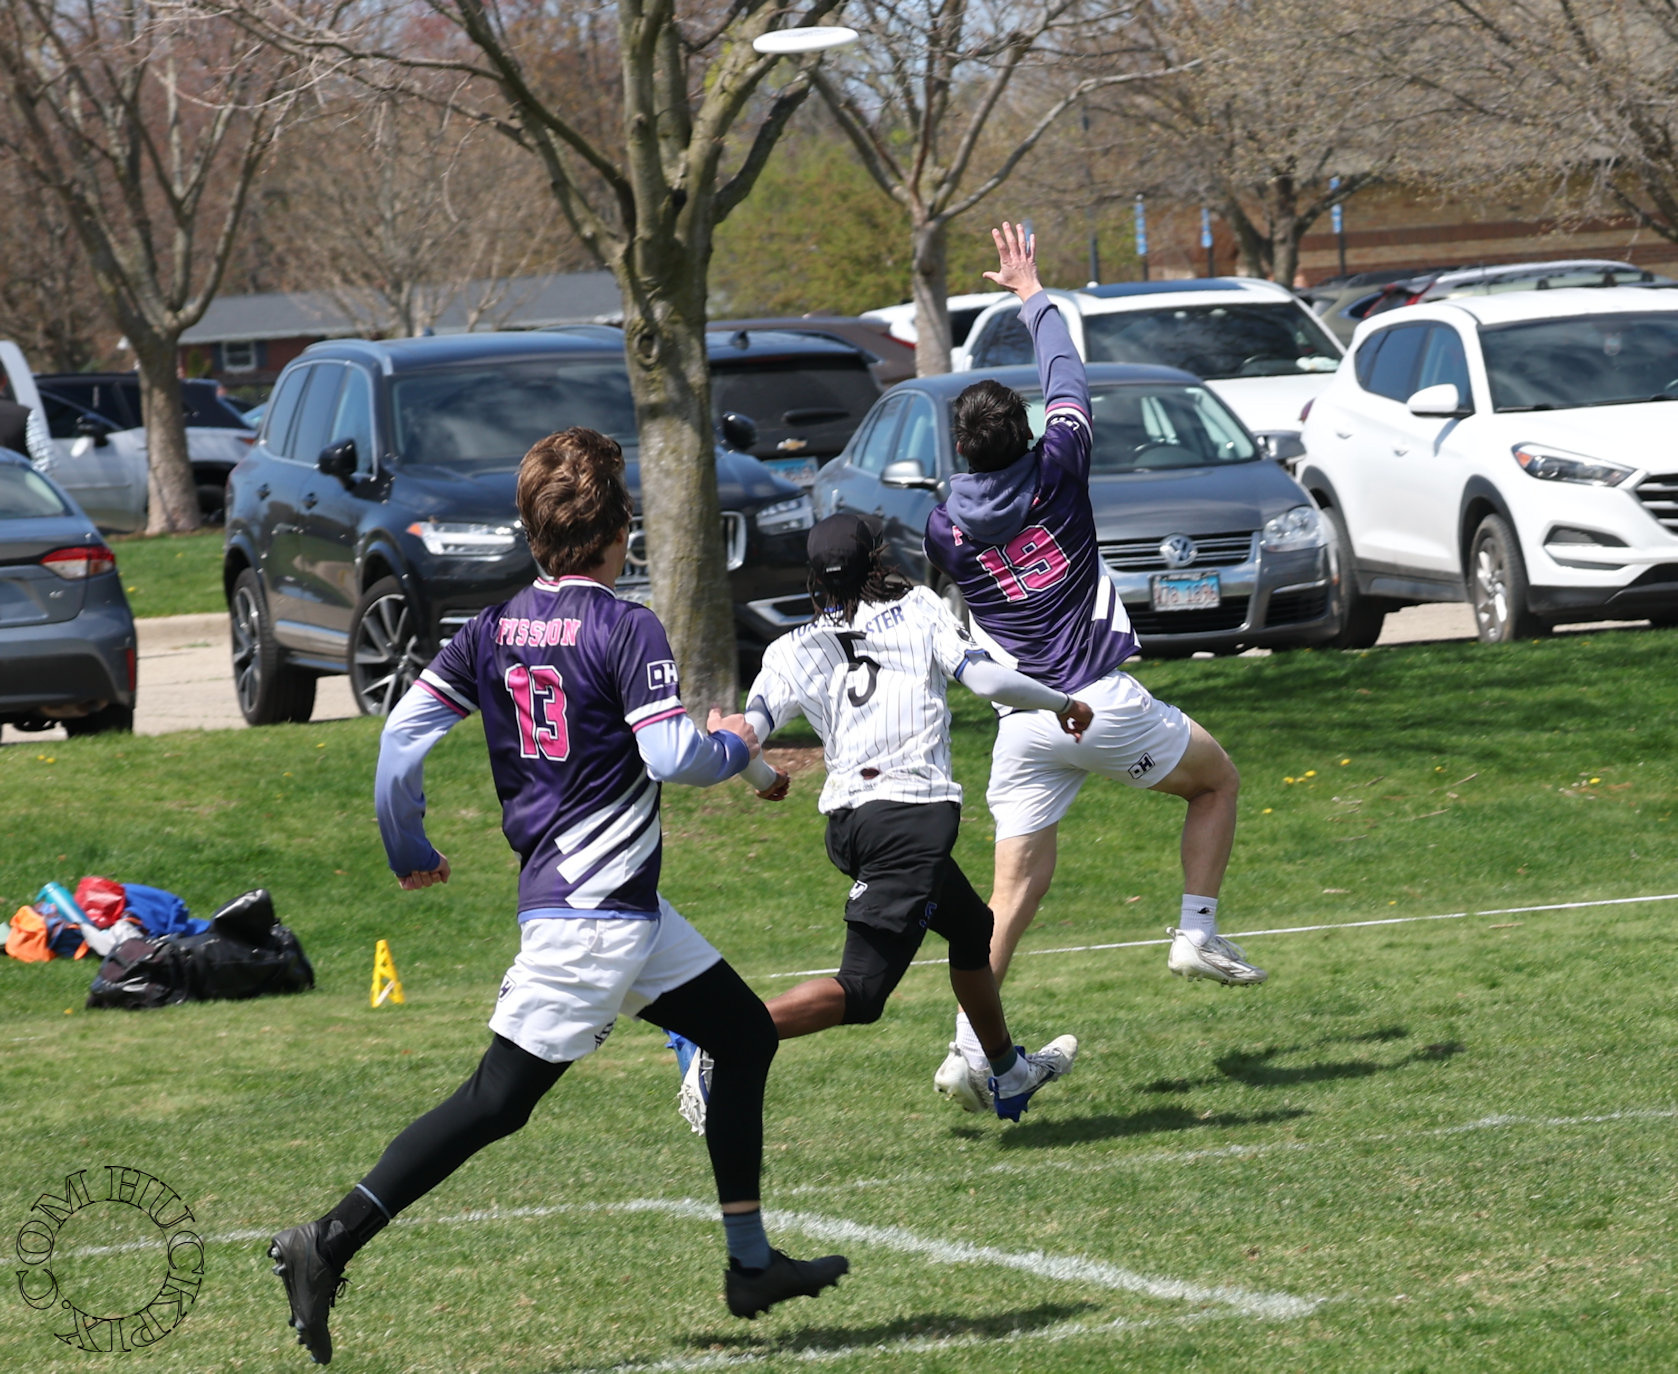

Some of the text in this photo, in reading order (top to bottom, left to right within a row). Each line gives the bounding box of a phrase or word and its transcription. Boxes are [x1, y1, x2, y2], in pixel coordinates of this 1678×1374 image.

[976, 525, 1071, 602] 19
[847, 630, 881, 708] 5
[505, 663, 570, 762] 13
